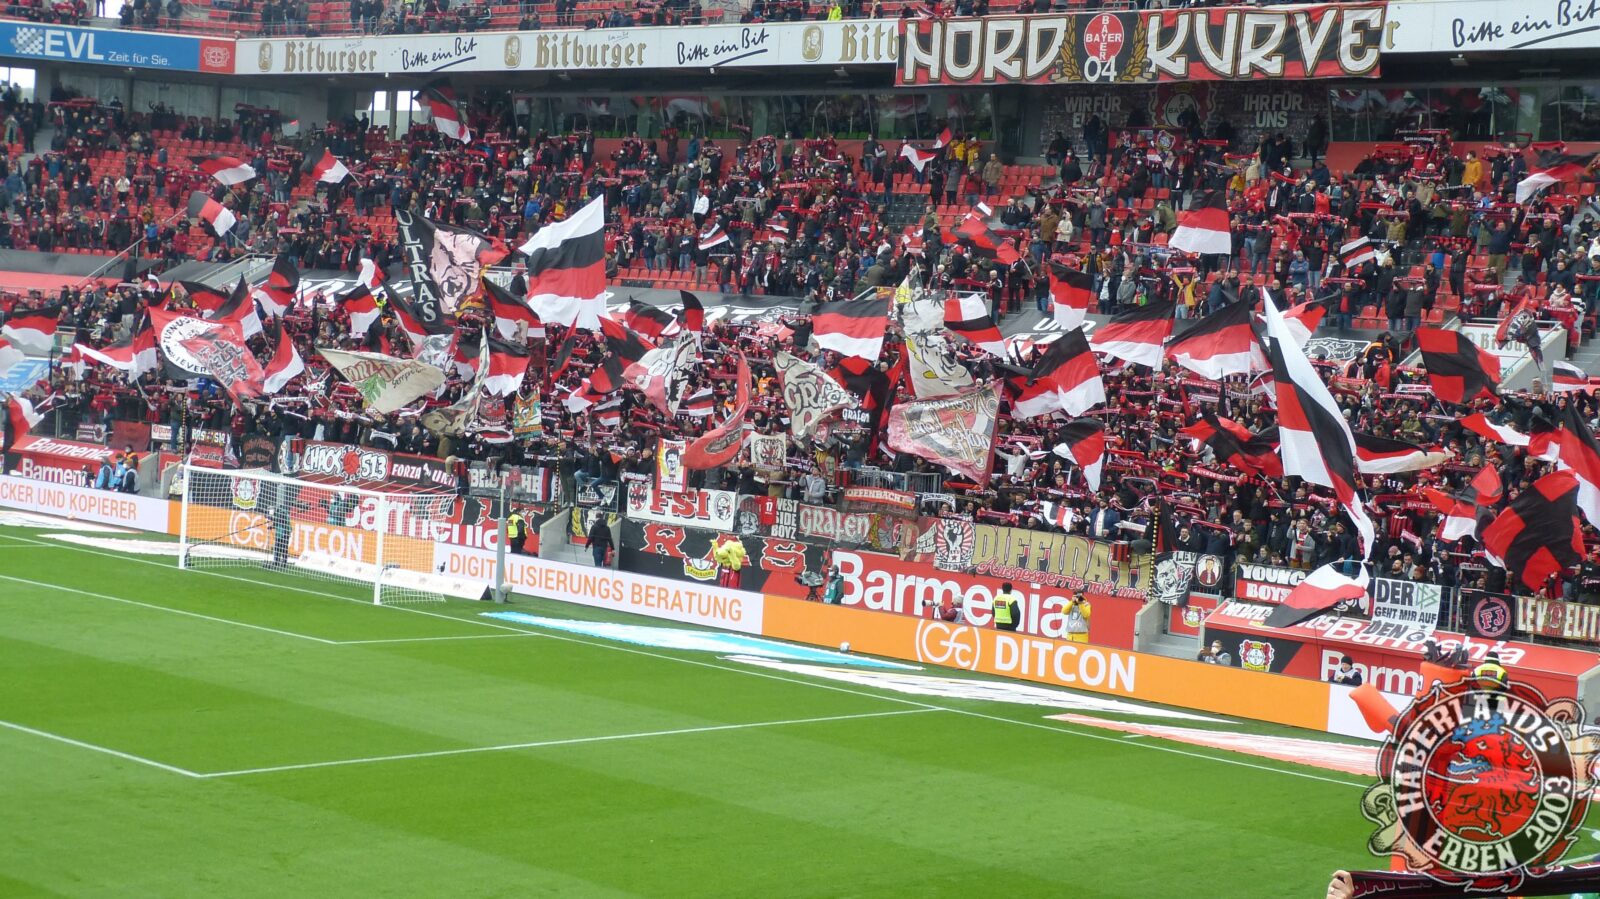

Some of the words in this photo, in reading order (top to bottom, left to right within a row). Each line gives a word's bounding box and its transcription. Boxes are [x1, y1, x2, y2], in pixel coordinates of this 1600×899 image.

[44, 29, 104, 60] EVL
[677, 40, 709, 66] Bitte
[713, 41, 739, 57] ein
[741, 28, 770, 50] Bit
[904, 16, 1069, 82] NORD
[1146, 6, 1386, 79] KURVE
[1085, 33, 1122, 43] BAYER
[1099, 15, 1110, 61] BAYER
[1452, 18, 1504, 49] Bitte
[1510, 20, 1552, 35] ein
[108, 50, 130, 63] Zeit
[133, 51, 149, 66] für
[151, 52, 171, 67] Sie.
[283, 40, 378, 73] Bitburger
[402, 48, 429, 71] Bitte
[431, 47, 453, 63] ein
[454, 36, 478, 56] Bit
[535, 34, 647, 69] Bitburger
[1084, 55, 1118, 82] 04
[1064, 97, 1094, 112] WIR
[1094, 94, 1122, 112] FÜR
[1244, 95, 1275, 111] IHR
[1275, 93, 1303, 112] FÜR
[1255, 111, 1289, 129] UNS
[397, 208, 438, 323] ULTRAS
[302, 445, 343, 476] CHAOS
[360, 452, 388, 481] 513
[391, 463, 422, 479] FORZA
[0, 483, 34, 506] CKER
[38, 488, 65, 510] UND
[70, 492, 137, 521] KOPIERER
[650, 488, 711, 522] FSI
[290, 522, 364, 561] ITCON
[771, 524, 797, 540] BOYZ
[1176, 550, 1197, 562] LEV
[975, 556, 1084, 591] Ausgesperrte
[1087, 578, 1115, 596] mit
[630, 581, 743, 622] BERATUNG
[832, 550, 1069, 639] Barmeia
[1376, 579, 1415, 607] DER
[1363, 620, 1408, 639] DEN
[1374, 606, 1398, 620] GEHT
[1400, 609, 1418, 623] MIR
[1418, 611, 1437, 625] AUF
[1517, 596, 1549, 632] LEV
[1562, 603, 1600, 639] ELIT
[995, 634, 1136, 692] DITCON
